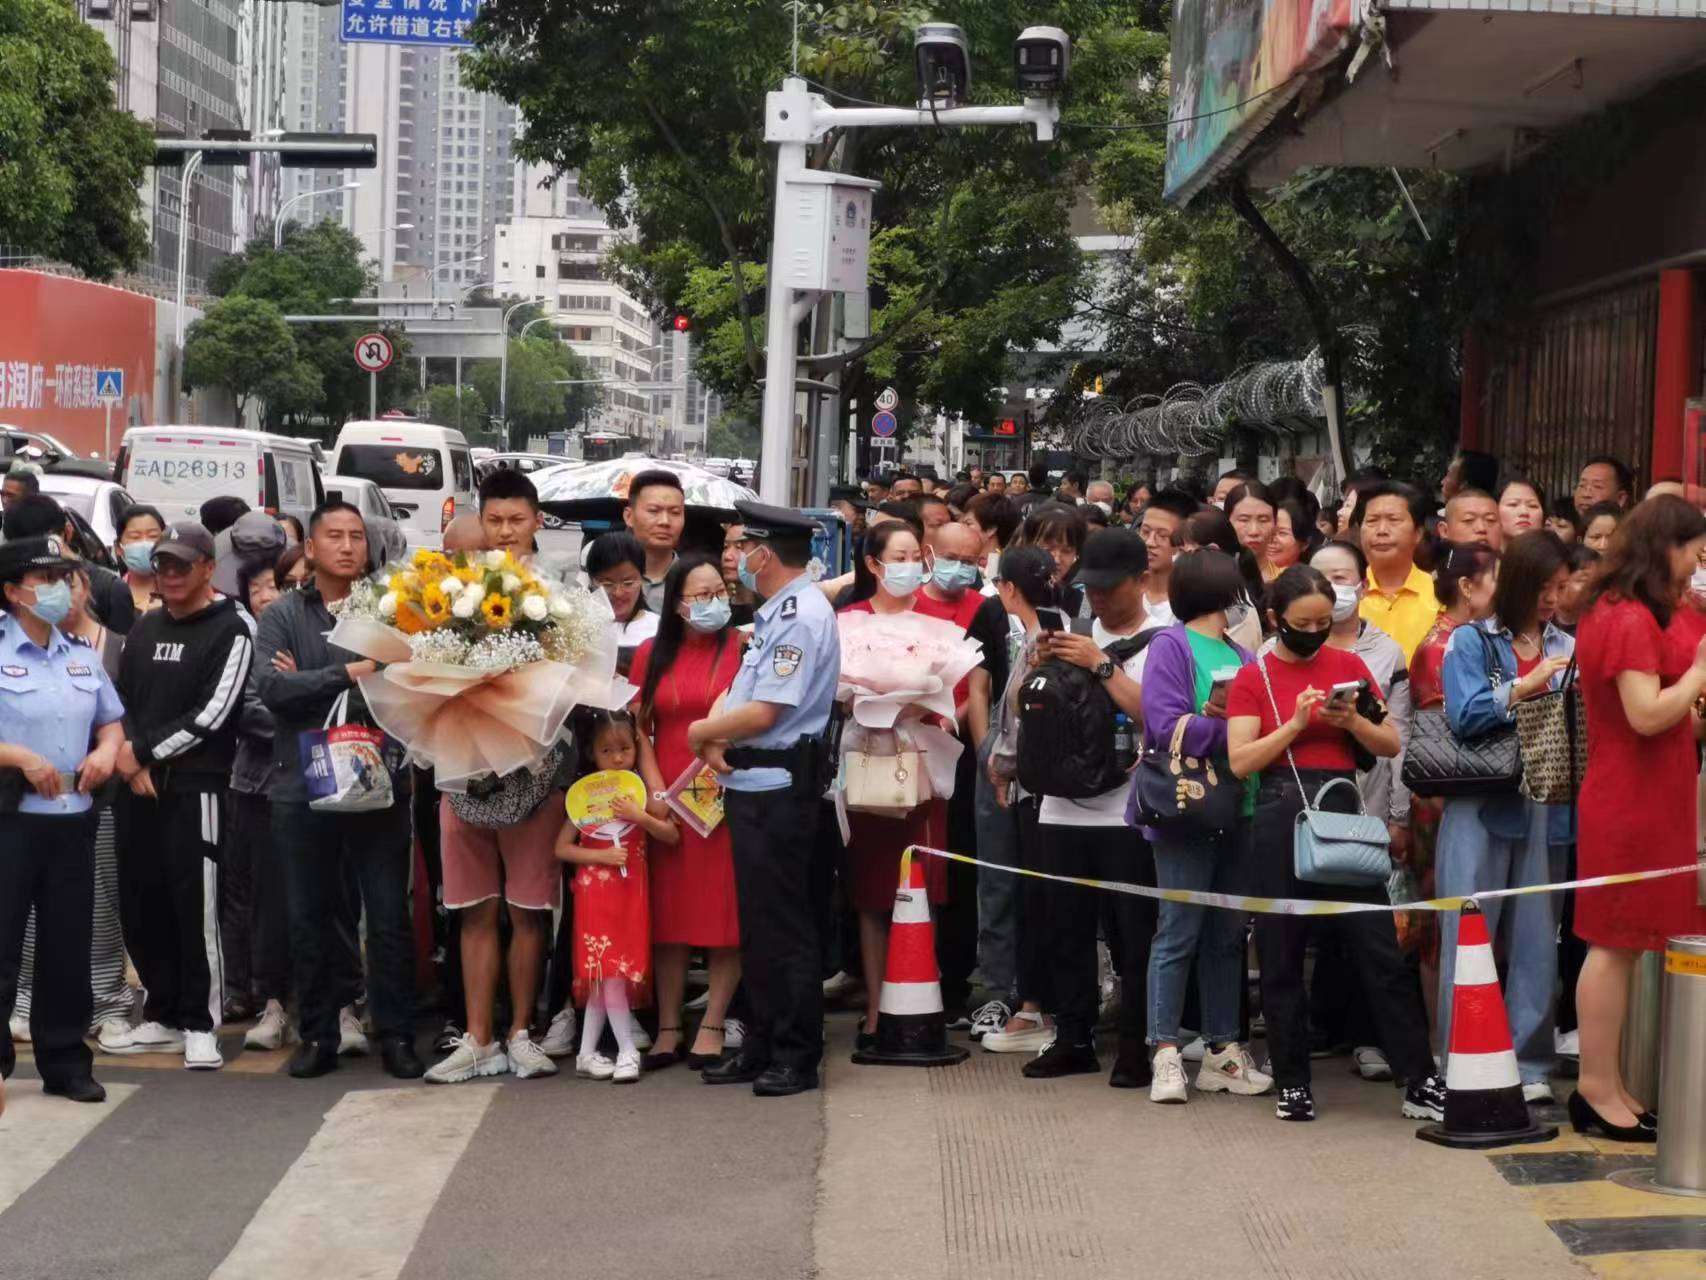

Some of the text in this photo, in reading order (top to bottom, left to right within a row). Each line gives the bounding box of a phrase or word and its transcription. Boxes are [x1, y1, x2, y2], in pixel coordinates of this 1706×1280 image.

[347, 13, 472, 38] 允许借道右转
[880, 394, 893, 404] 40
[134, 459, 246, 479] 云AD26913
[152, 642, 185, 662] KIM
